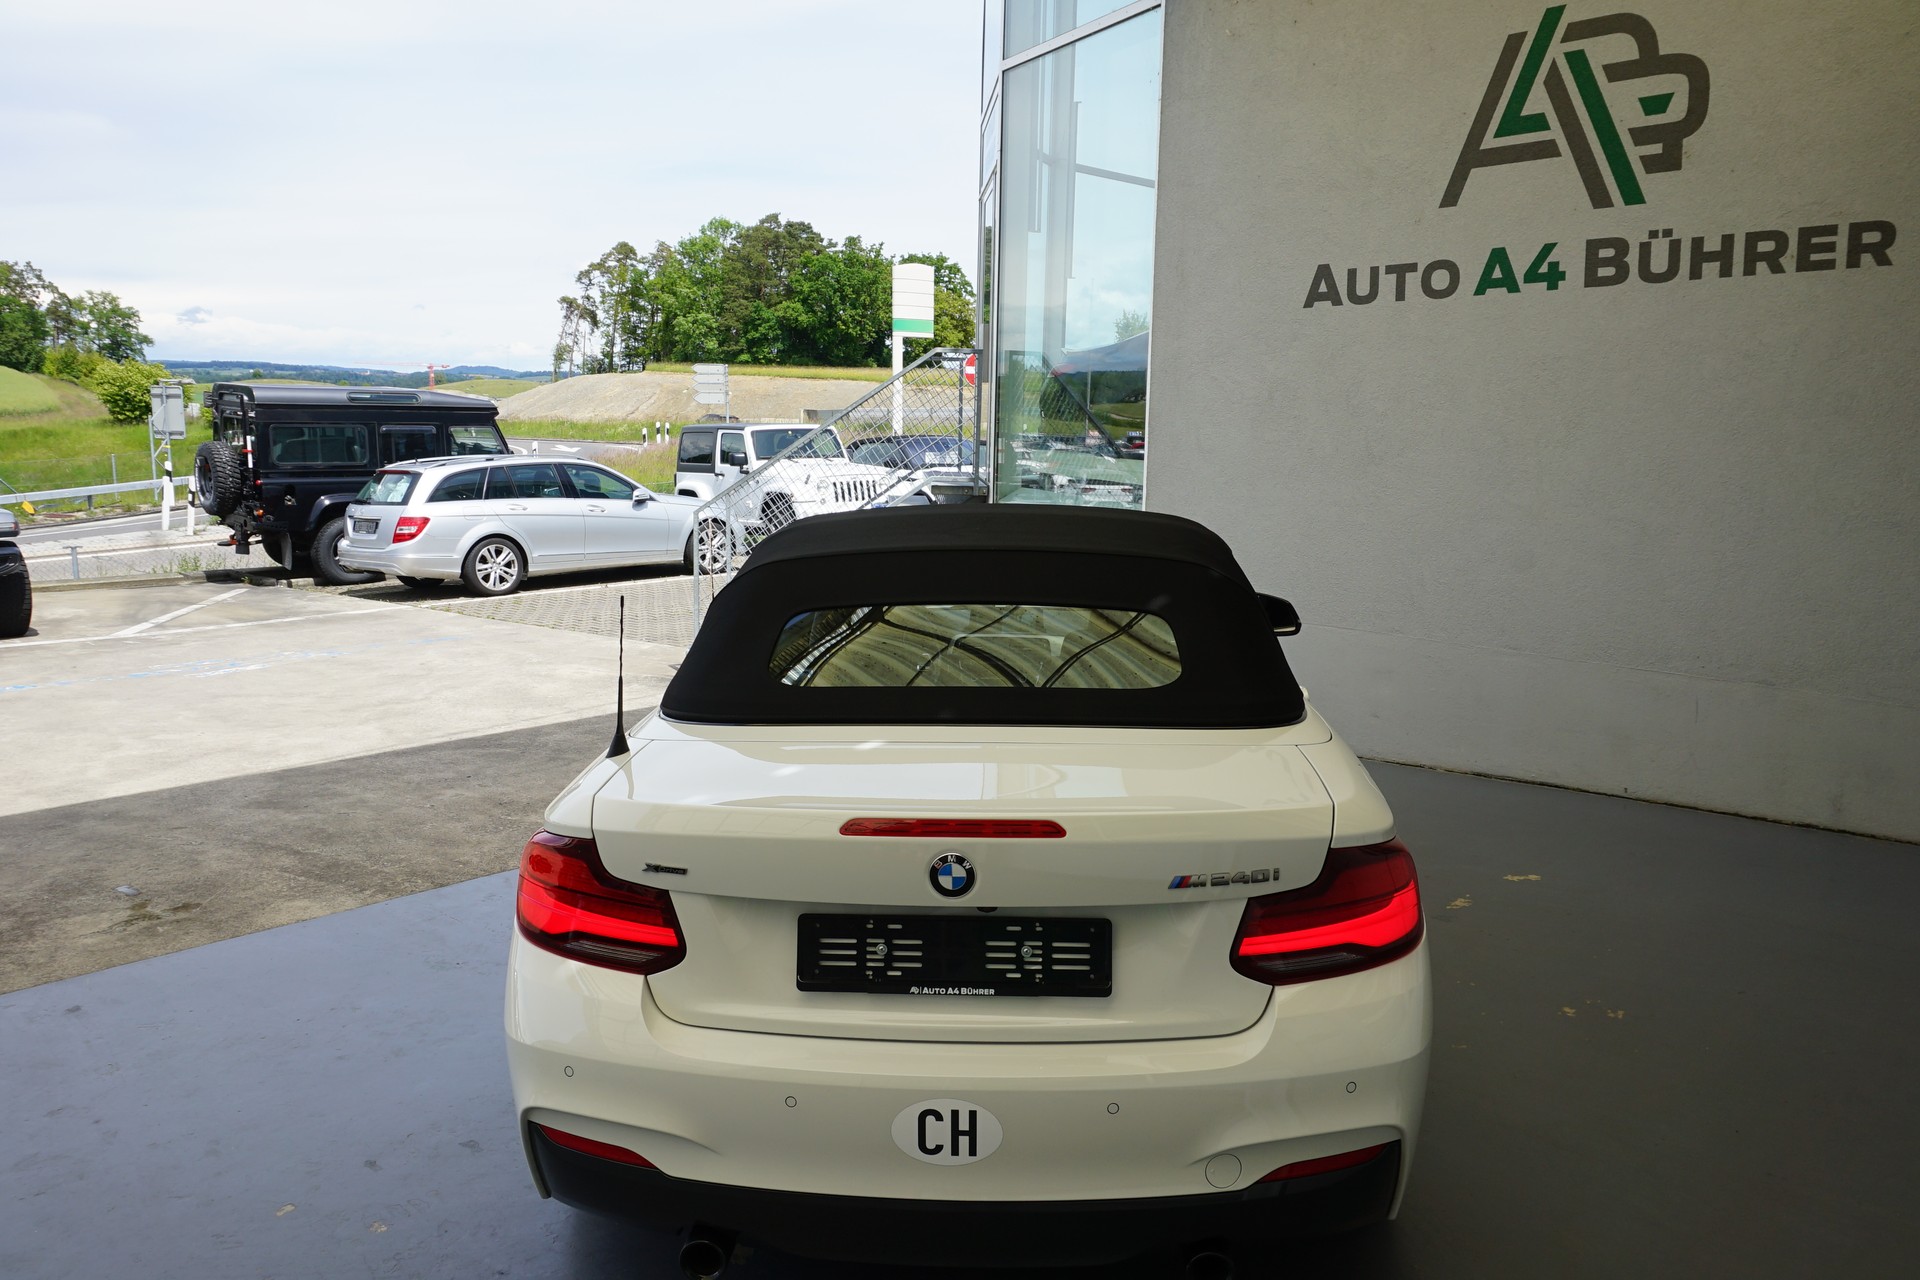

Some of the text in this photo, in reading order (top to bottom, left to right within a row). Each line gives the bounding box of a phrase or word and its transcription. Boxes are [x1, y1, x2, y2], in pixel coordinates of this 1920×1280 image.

[1303, 219, 1897, 309] AUTO A4 BÜHRER
[934, 855, 972, 870] BMW
[922, 986, 946, 994] AUTO
[947, 987, 960, 995] A4
[960, 986, 995, 995] BÜHRER
[917, 1108, 978, 1157] CH
